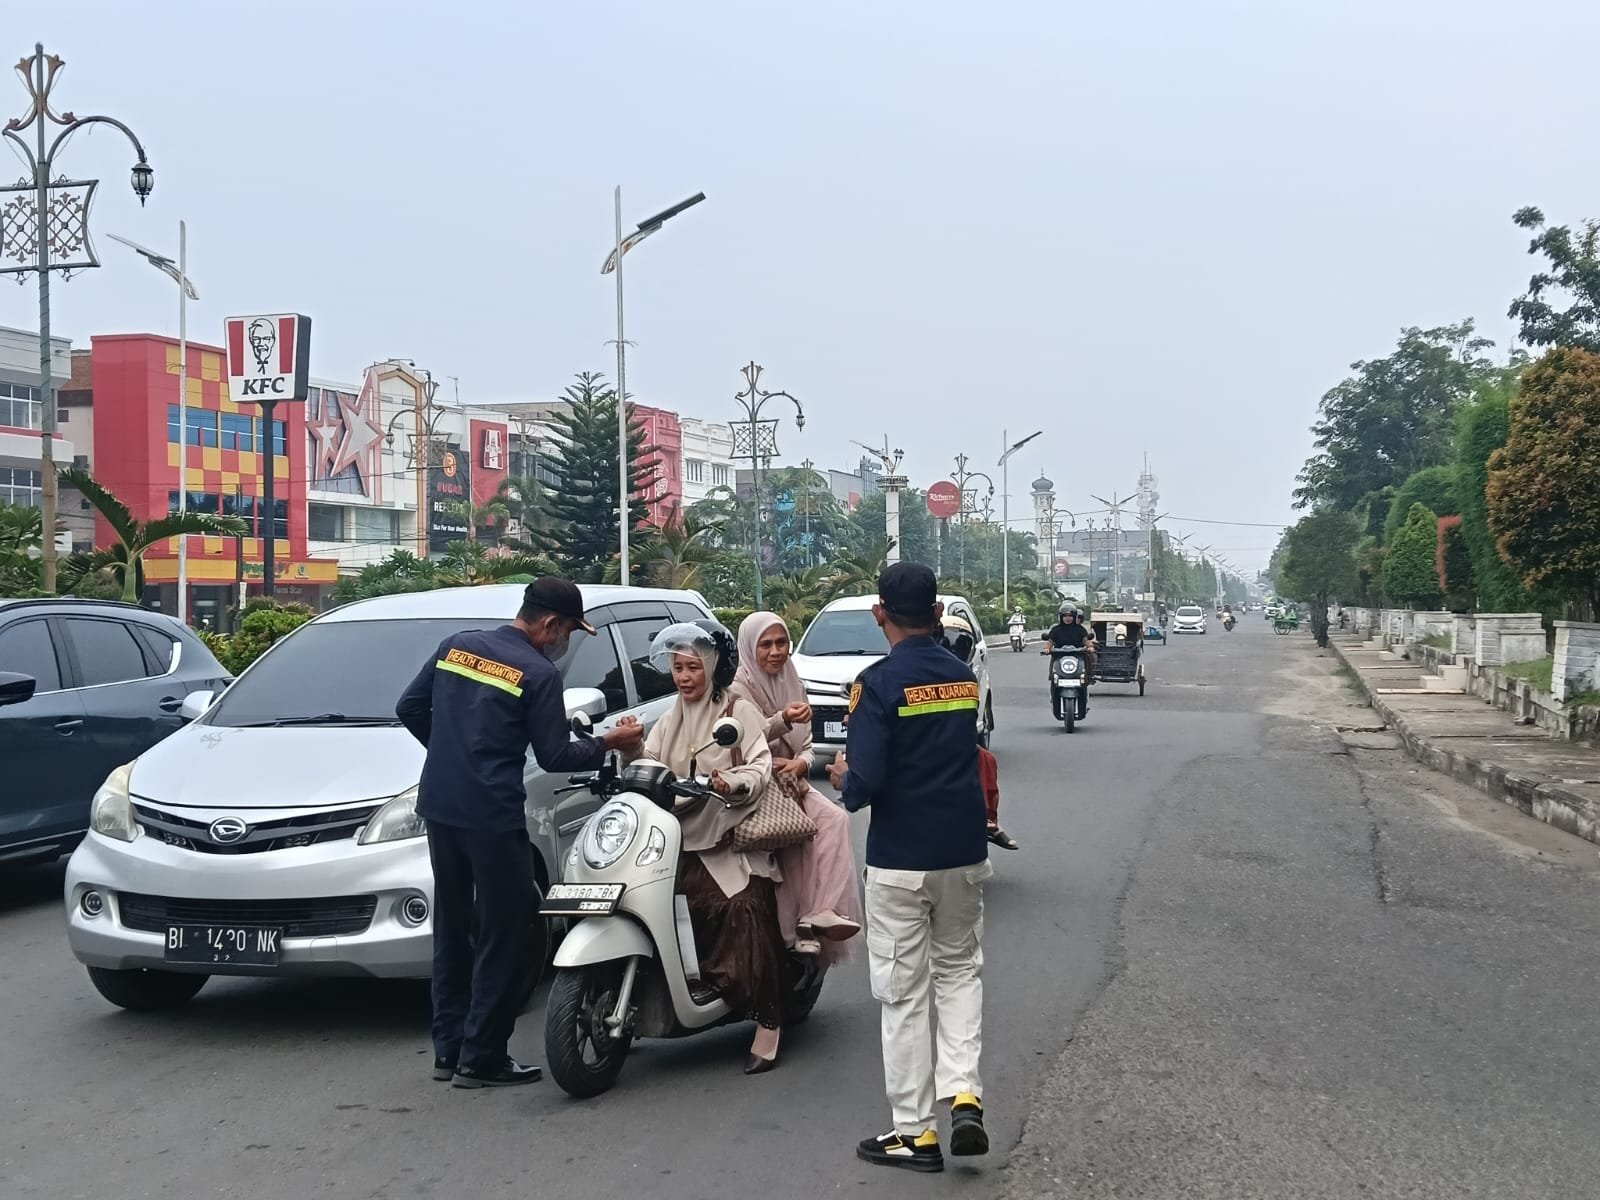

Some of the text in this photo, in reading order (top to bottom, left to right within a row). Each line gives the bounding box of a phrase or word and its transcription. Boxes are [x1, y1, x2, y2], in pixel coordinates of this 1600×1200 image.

[242, 377, 285, 395] KFC
[449, 652, 519, 682] HEALTH QUARANTINE
[909, 688, 937, 702] HEALTH
[257, 930, 277, 953] NK
